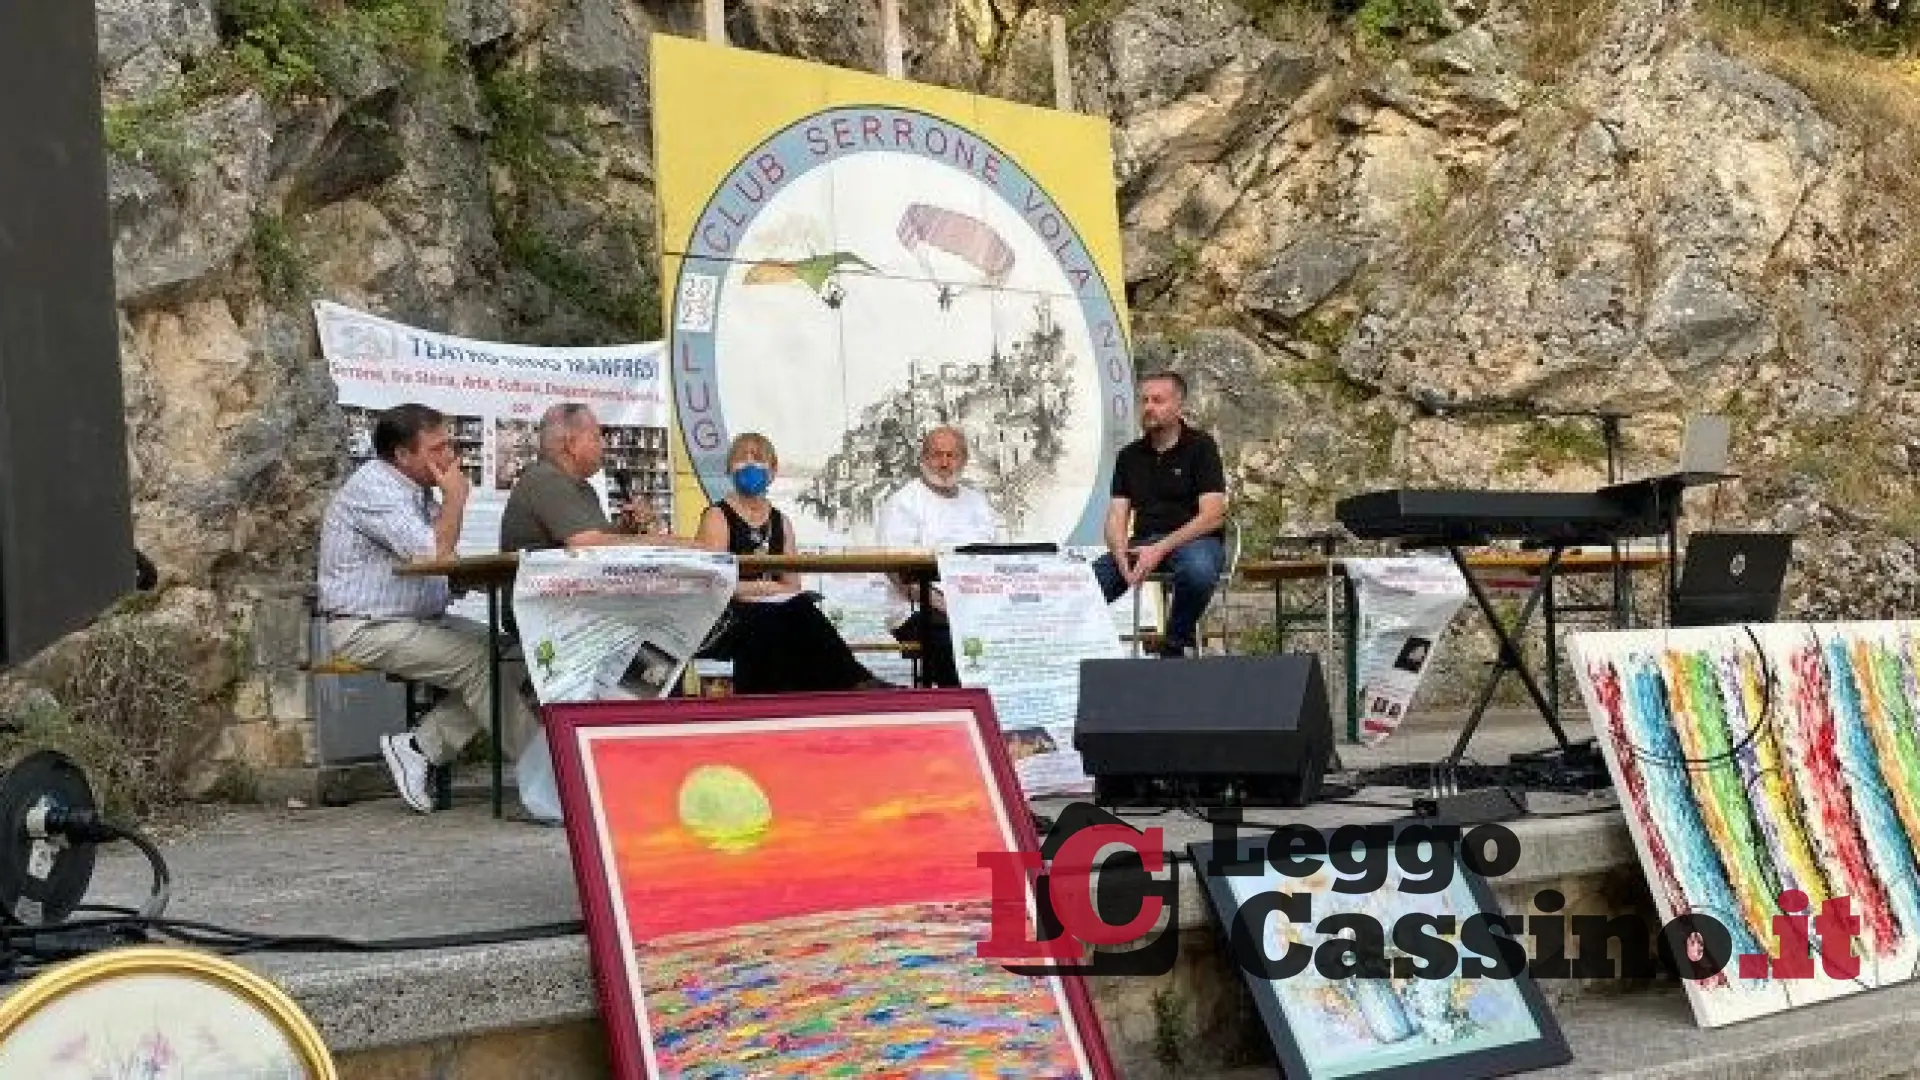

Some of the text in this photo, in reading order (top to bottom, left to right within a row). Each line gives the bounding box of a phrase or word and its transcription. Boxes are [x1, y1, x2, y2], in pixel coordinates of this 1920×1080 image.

[702, 152, 786, 256] CLUB
[805, 115, 1001, 186] SERRONE
[1023, 187, 1091, 291] VOLA
[682, 341, 721, 449] LUG
